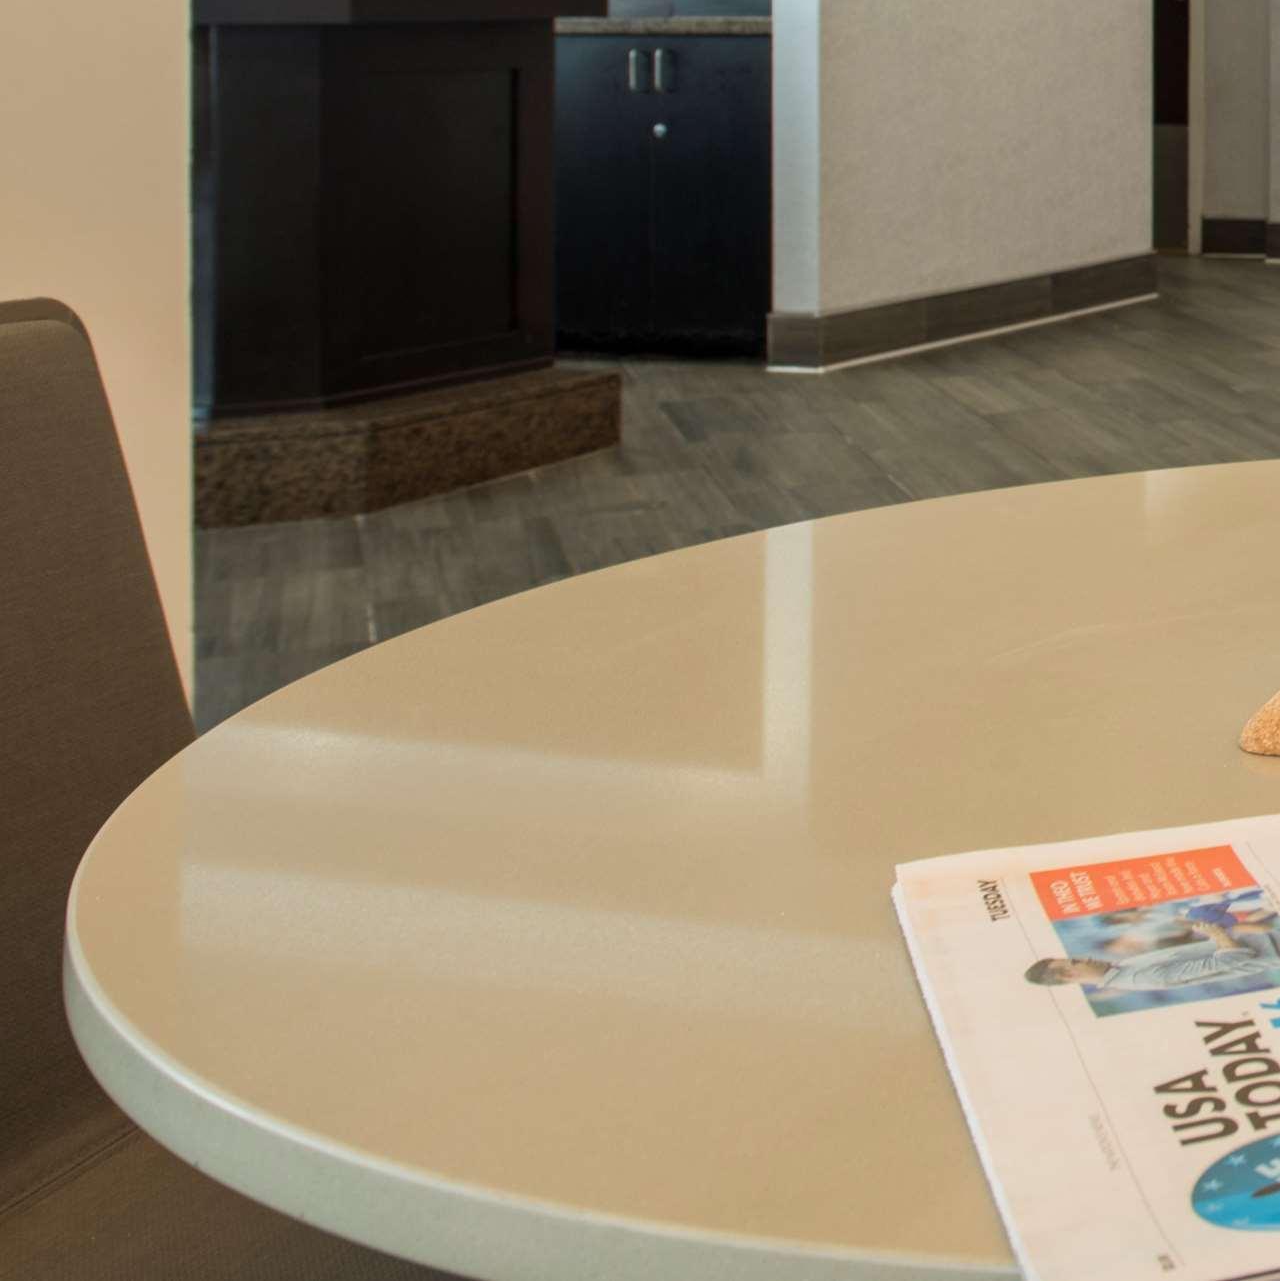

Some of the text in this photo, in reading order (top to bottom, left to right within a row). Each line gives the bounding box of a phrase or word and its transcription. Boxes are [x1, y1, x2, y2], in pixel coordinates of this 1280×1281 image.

[977, 878, 1012, 922] TUESDAY
[1069, 871, 1097, 895] TRUST
[1152, 1068, 1240, 1146] USA
